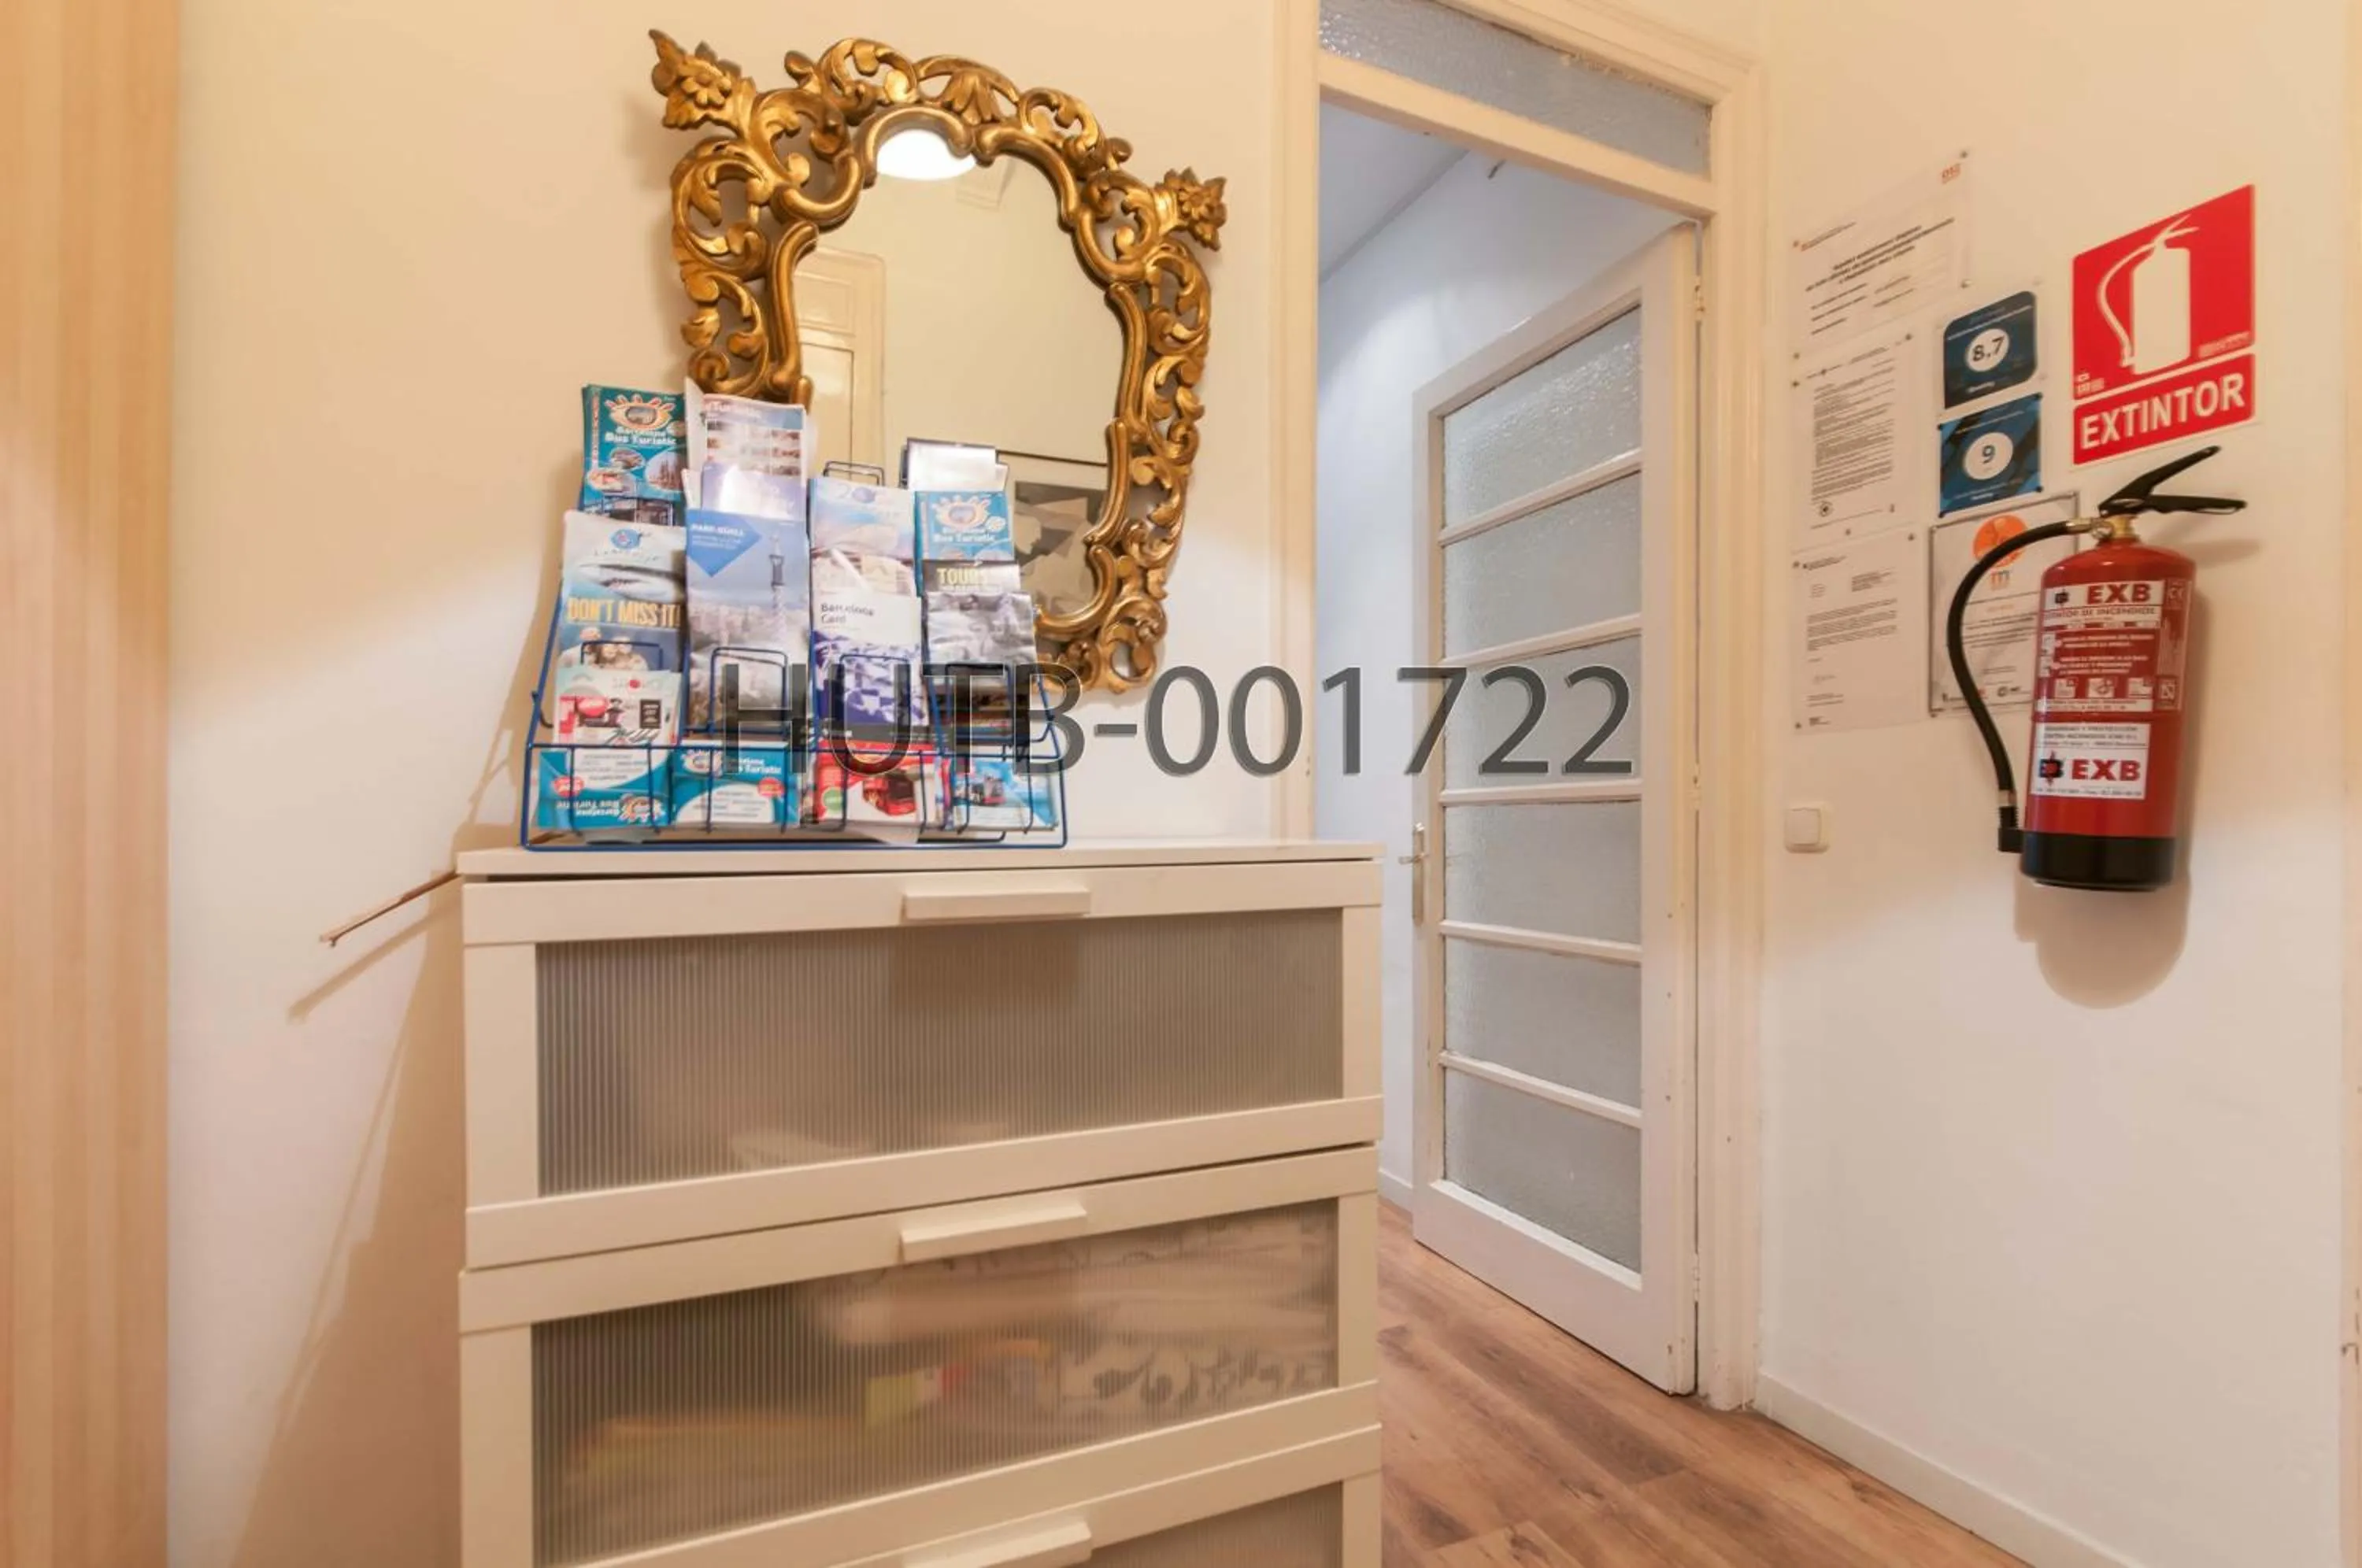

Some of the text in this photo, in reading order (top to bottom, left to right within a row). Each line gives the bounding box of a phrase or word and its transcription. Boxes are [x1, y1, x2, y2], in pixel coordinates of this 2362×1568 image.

[1973, 336, 2005, 362] 8.7
[2080, 372, 2245, 449] EXTINTOR
[1982, 444, 1996, 464] 9
[2087, 583, 2151, 605] EXB
[617, 600, 658, 627] MISS
[2071, 758, 2141, 782] EXB
